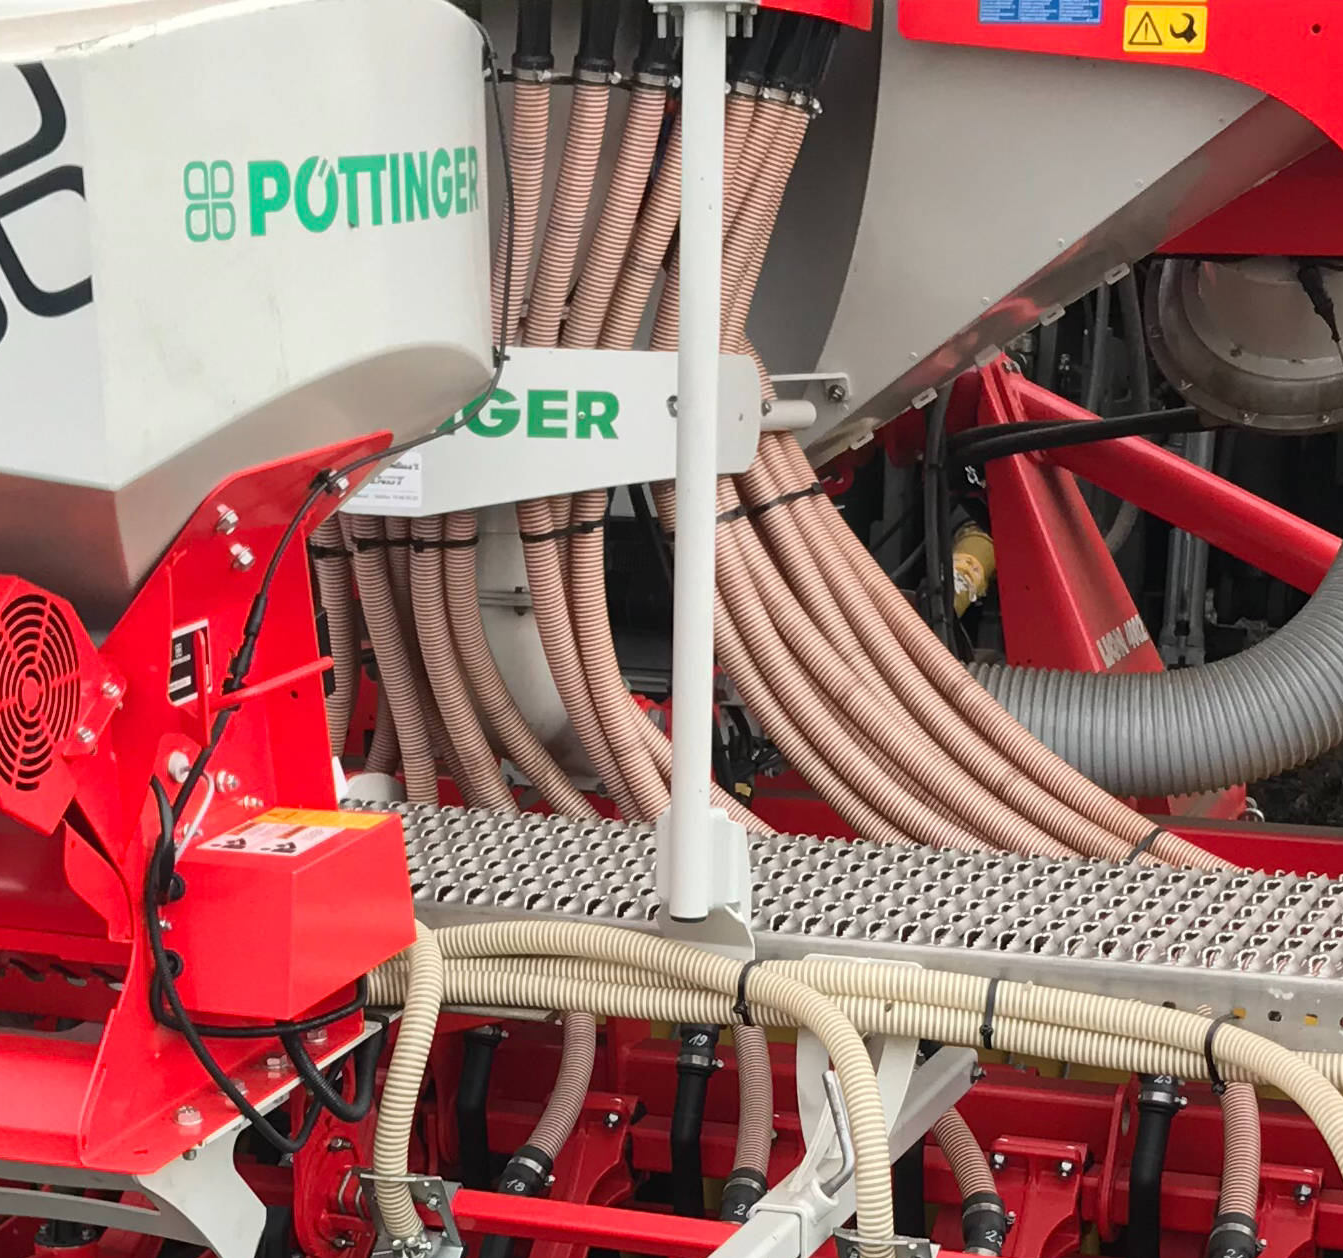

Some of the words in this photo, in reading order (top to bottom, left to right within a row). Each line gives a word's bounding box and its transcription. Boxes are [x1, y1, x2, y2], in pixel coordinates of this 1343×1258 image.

[247, 145, 479, 237] PÖTTINGER
[689, 1033, 708, 1046] 19
[506, 1179, 525, 1191] 18
